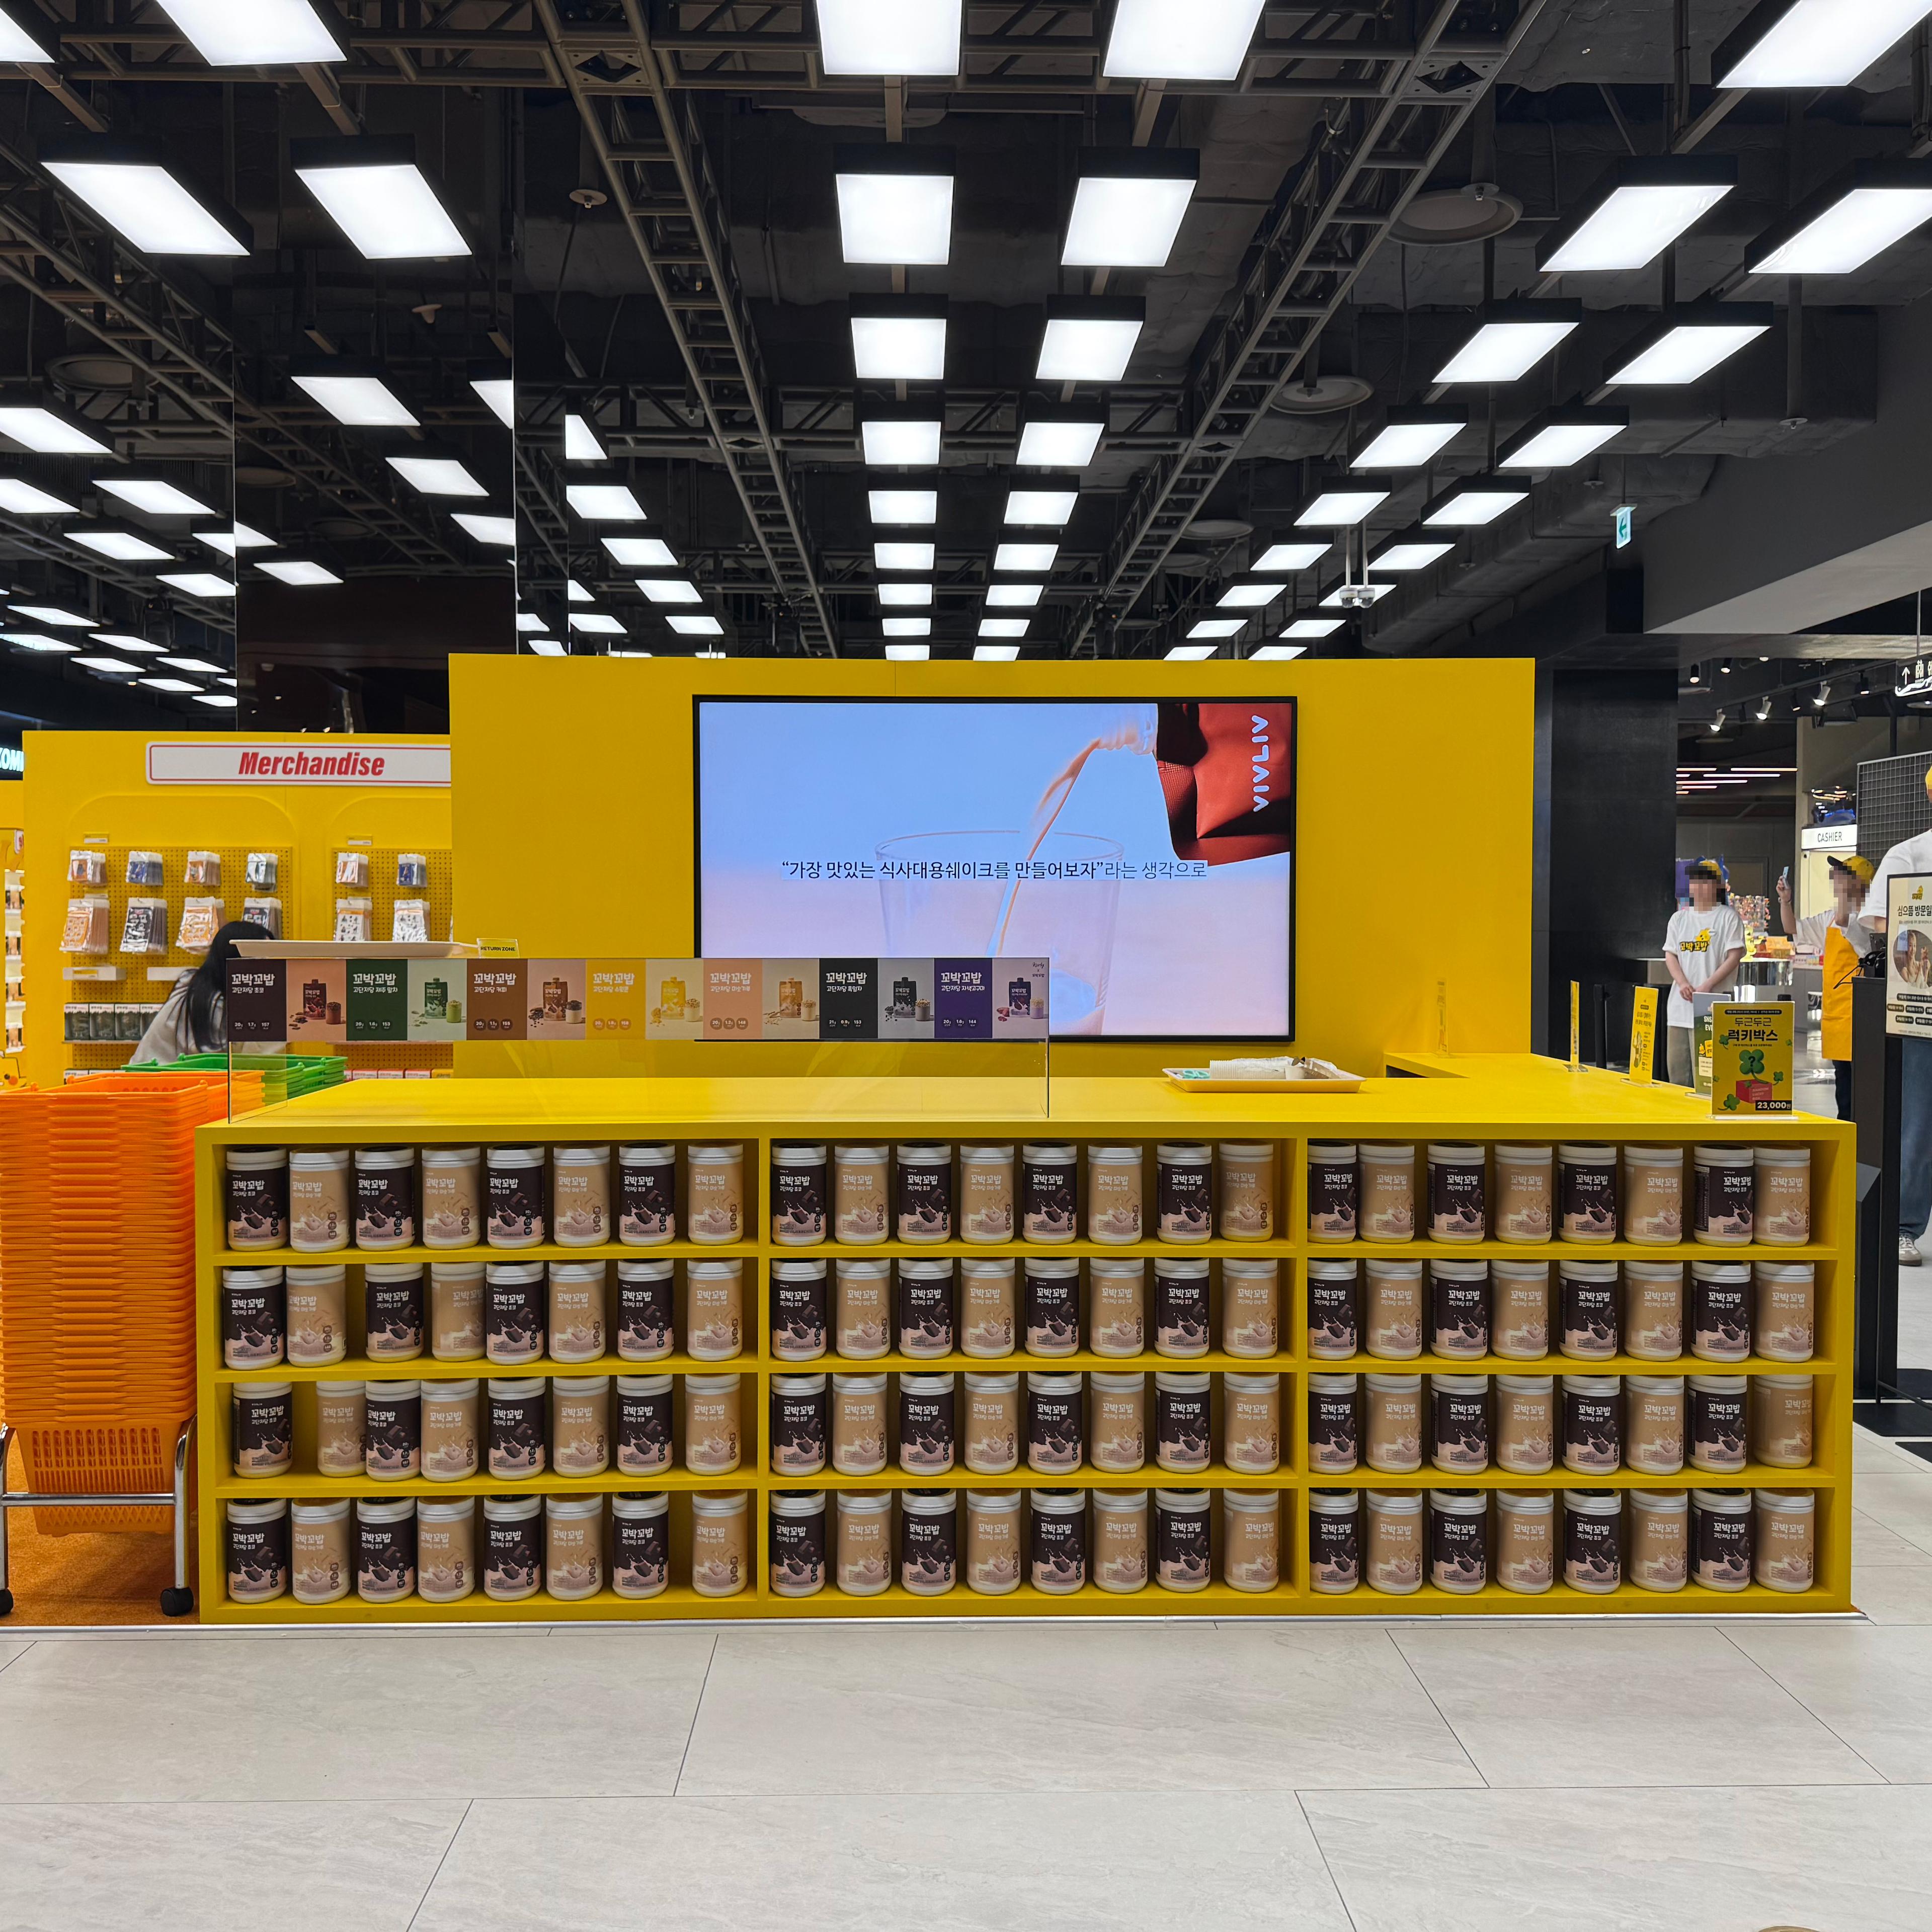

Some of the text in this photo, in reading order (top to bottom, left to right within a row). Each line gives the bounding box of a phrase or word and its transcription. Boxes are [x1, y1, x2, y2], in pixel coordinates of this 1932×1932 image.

[238, 752, 385, 776] Merchandise
[1251, 715, 1270, 812] VIVLIV
[1817, 832, 1842, 842] CASHIER
[782, 861, 822, 879] “가장
[827, 861, 875, 879] 맛있는
[879, 861, 1010, 879] 식사대용쉐이크를
[1142, 861, 1207, 879] 생각으로
[1897, 905, 1913, 916] 심으뜸
[231, 974, 275, 986] 꼬박꼬밥
[353, 974, 396, 986] 꼬박꼬밥
[474, 973, 517, 985] 꼬박꼬밥
[593, 973, 634, 985] 꼬박꼬밥
[710, 973, 751, 984] 꼬박꼬밥
[826, 973, 867, 984] 꼬박꼬밥
[941, 972, 982, 984] 꼬박꼬밥
[1735, 1017, 1771, 1026] 두근두근
[1728, 1029, 1778, 1041] 럭키박스
[1757, 1102, 1791, 1110] 23,000원
[490, 1178, 519, 1188] 꼬박꼬밥
[624, 1175, 655, 1186] 꼬박꼬밥
[779, 1175, 811, 1186] 꼬박꼬밥
[907, 1175, 938, 1185] 꼬박꼬밥
[1032, 1174, 1064, 1185] 꼬박꼬밥
[1172, 1174, 1203, 1185] 꼬박꼬밥
[1324, 1173, 1353, 1184] 꼬박꼬밥
[1446, 1175, 1478, 1185] 꼬박꼬밥
[1576, 1174, 1608, 1185] 꼬박꼬밥
[1723, 1176, 1751, 1187] 꼬박꼬밥
[232, 1180, 265, 1191] 꼬박꼬밥
[358, 1179, 388, 1190] 꼬박꼬밥
[376, 1291, 410, 1302] 꼬박꼬밥
[622, 1291, 653, 1302] 꼬박꼬밥
[779, 1290, 811, 1301] 꼬박꼬밥
[911, 1289, 942, 1300] 꼬박꼬밥
[1036, 1287, 1068, 1299] 꼬박꼬밥
[1168, 1288, 1199, 1299] 꼬박꼬밥
[1314, 1289, 1346, 1300] 꼬박꼬밥
[1448, 1290, 1480, 1301] 꼬박꼬밥
[1578, 1291, 1611, 1302] 꼬박꼬밥
[1708, 1292, 1741, 1303] 꼬박꼬밥
[231, 1298, 266, 1309] 꼬박꼬밥
[493, 1294, 526, 1305] 꼬박꼬밥
[251, 1405, 284, 1418] 꼬박꼬밥
[623, 1405, 654, 1417] 꼬박꼬밥
[784, 1404, 816, 1416] 꼬박꼬밥
[908, 1404, 939, 1416] 꼬박꼬밥
[1037, 1404, 1068, 1415] 꼬박꼬밥
[1170, 1403, 1201, 1414] 꼬박꼬밥
[1320, 1404, 1351, 1415] 꼬박꼬밥
[1450, 1404, 1482, 1415] 꼬박꼬밥
[1578, 1405, 1611, 1416] 꼬박꼬밥
[1708, 1403, 1740, 1414] 꼬박꼬밥
[368, 1410, 396, 1422] 꼬박꼬밥
[493, 1409, 524, 1420] 꼬박꼬밥
[776, 1525, 807, 1537] 꼬박꼬밥
[909, 1523, 940, 1535] 꼬박꼬밥
[1040, 1522, 1072, 1535] 꼬박꼬밥
[1170, 1521, 1201, 1533] 꼬박꼬밥
[1321, 1523, 1352, 1535] 꼬박꼬밥
[1444, 1522, 1477, 1535] 꼬박꼬밥
[1576, 1522, 1610, 1535] 꼬박꼬밥
[1713, 1522, 1745, 1534] 꼬박꼬밥
[233, 1533, 265, 1544] 꼬박꼬밥
[361, 1532, 392, 1544] 꼬박꼬밥
[490, 1531, 522, 1542] 꼬박꼬밥
[622, 1527, 654, 1539] 꼬박꼬밥
